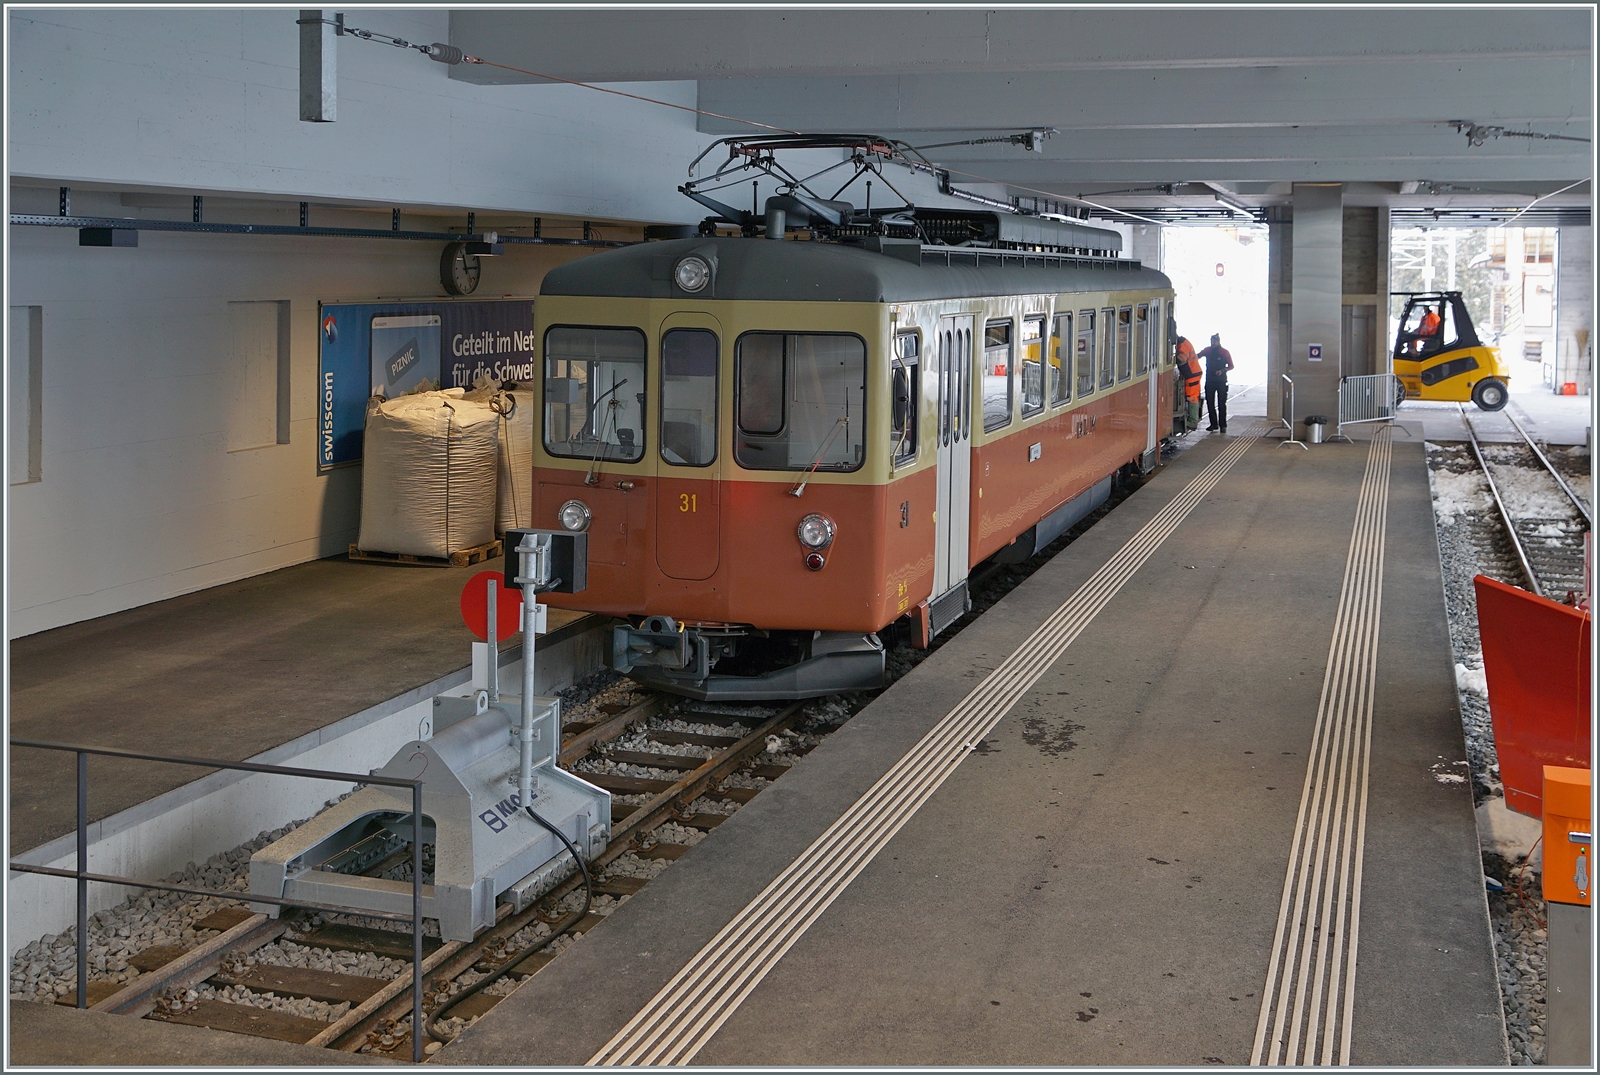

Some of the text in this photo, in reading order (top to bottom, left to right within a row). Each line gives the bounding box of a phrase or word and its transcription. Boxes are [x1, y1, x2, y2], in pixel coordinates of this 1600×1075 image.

[452, 331, 494, 357] Geteilt
[496, 331, 511, 354] im
[391, 348, 415, 376] PIZNIC
[452, 363, 470, 387] für
[322, 371, 334, 461] swisscom
[679, 493, 697, 513] 31
